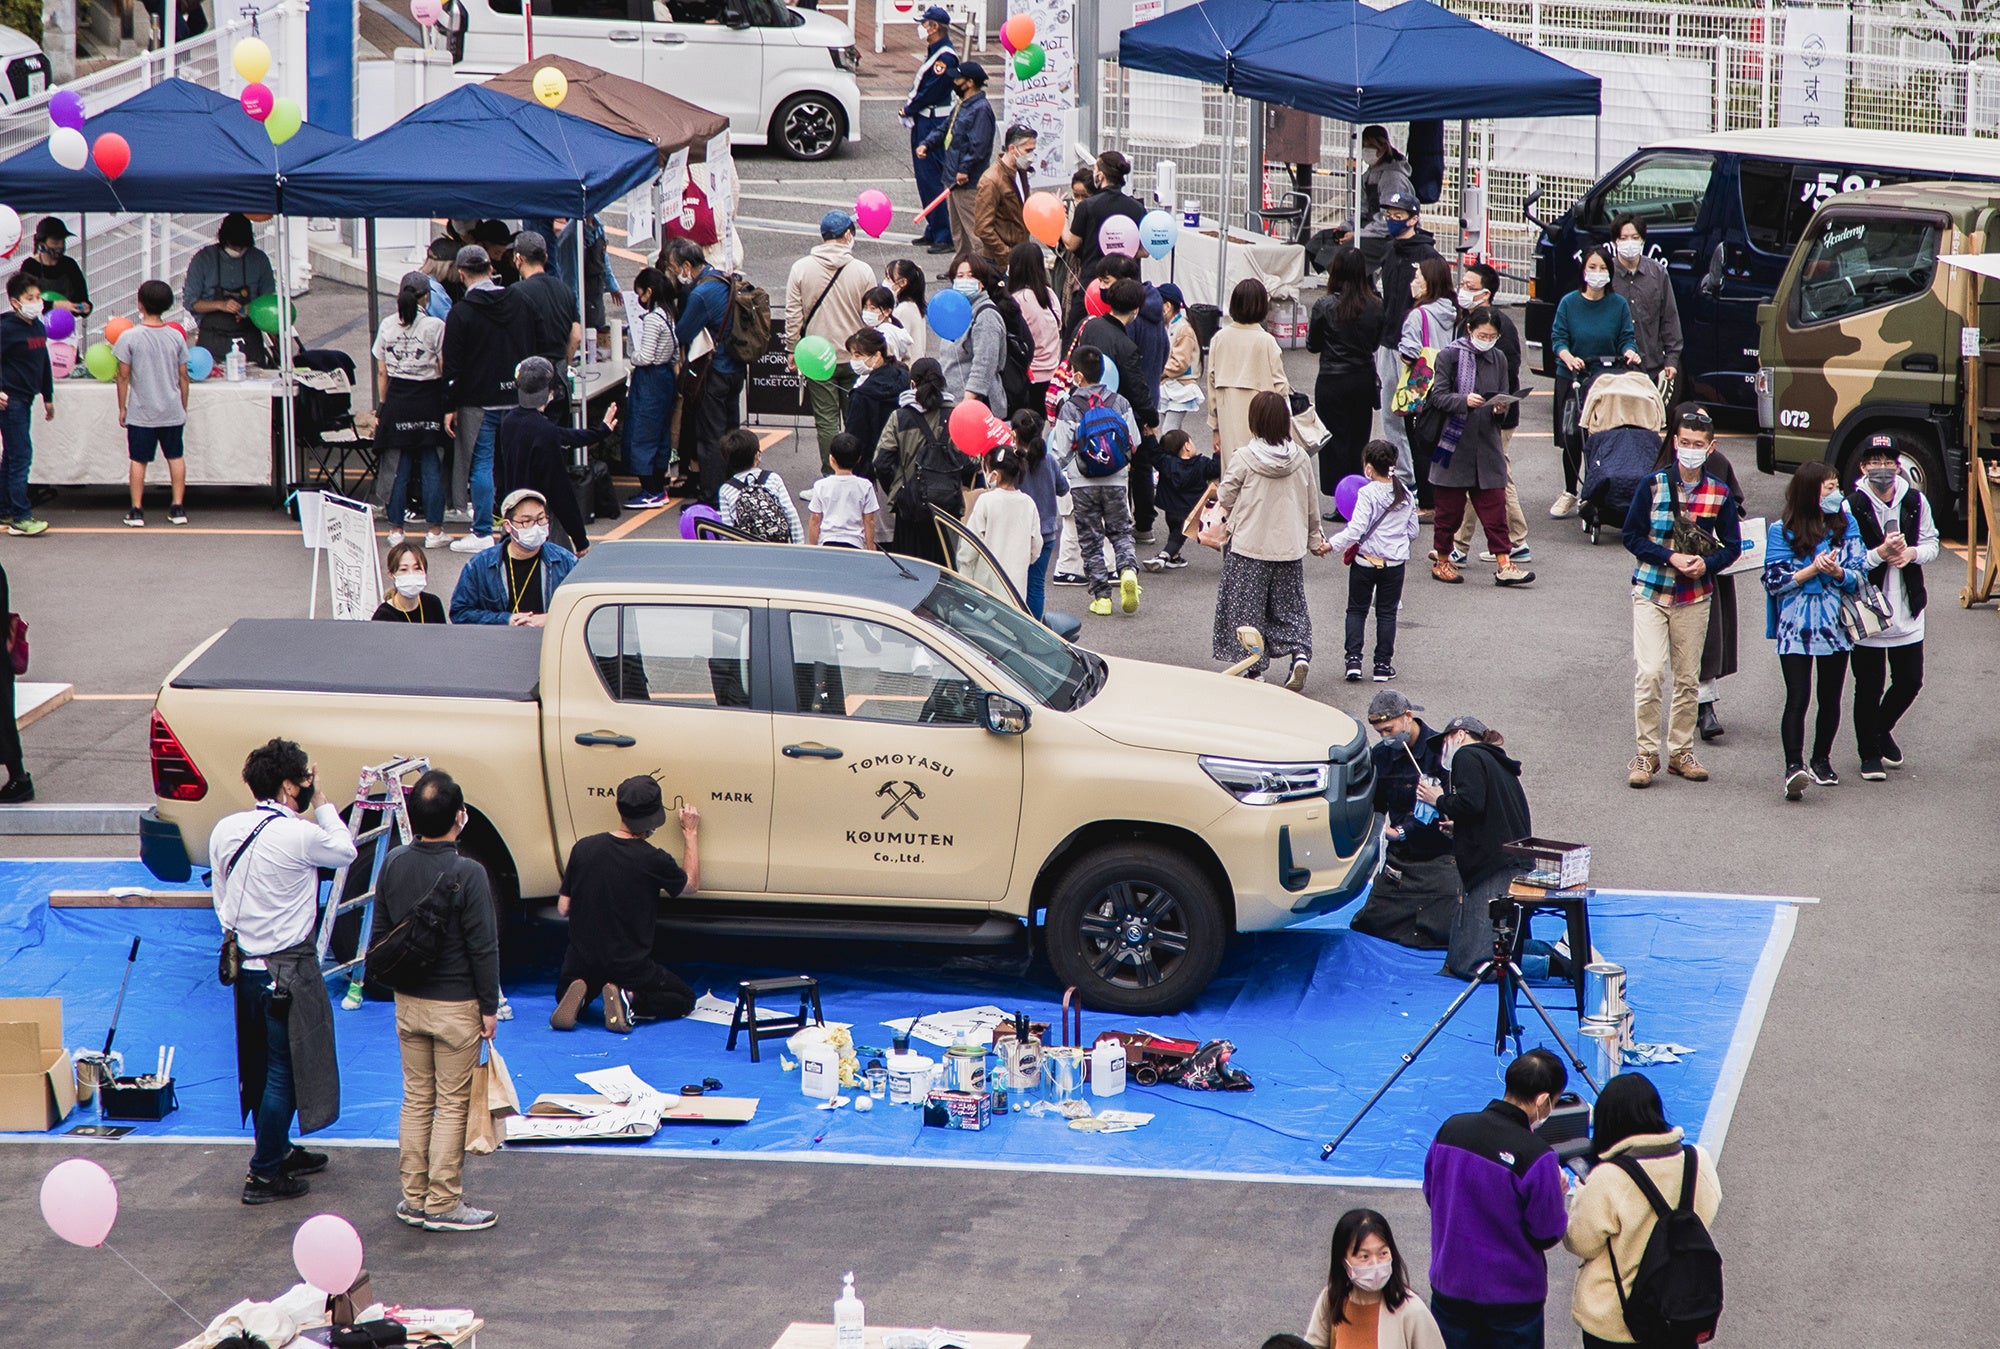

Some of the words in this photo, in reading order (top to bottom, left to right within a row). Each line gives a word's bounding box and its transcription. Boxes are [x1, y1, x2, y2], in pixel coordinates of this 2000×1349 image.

[753, 378, 782, 387] TICKET
[782, 379, 807, 387] COUN
[1780, 410, 1810, 428] 072
[848, 753, 954, 777] TOMOYASU
[587, 787, 616, 798] TRA
[711, 791, 753, 803] MARK
[846, 831, 954, 847] KOUMUTEN
[874, 852, 925, 864] Co.,Ltd.
